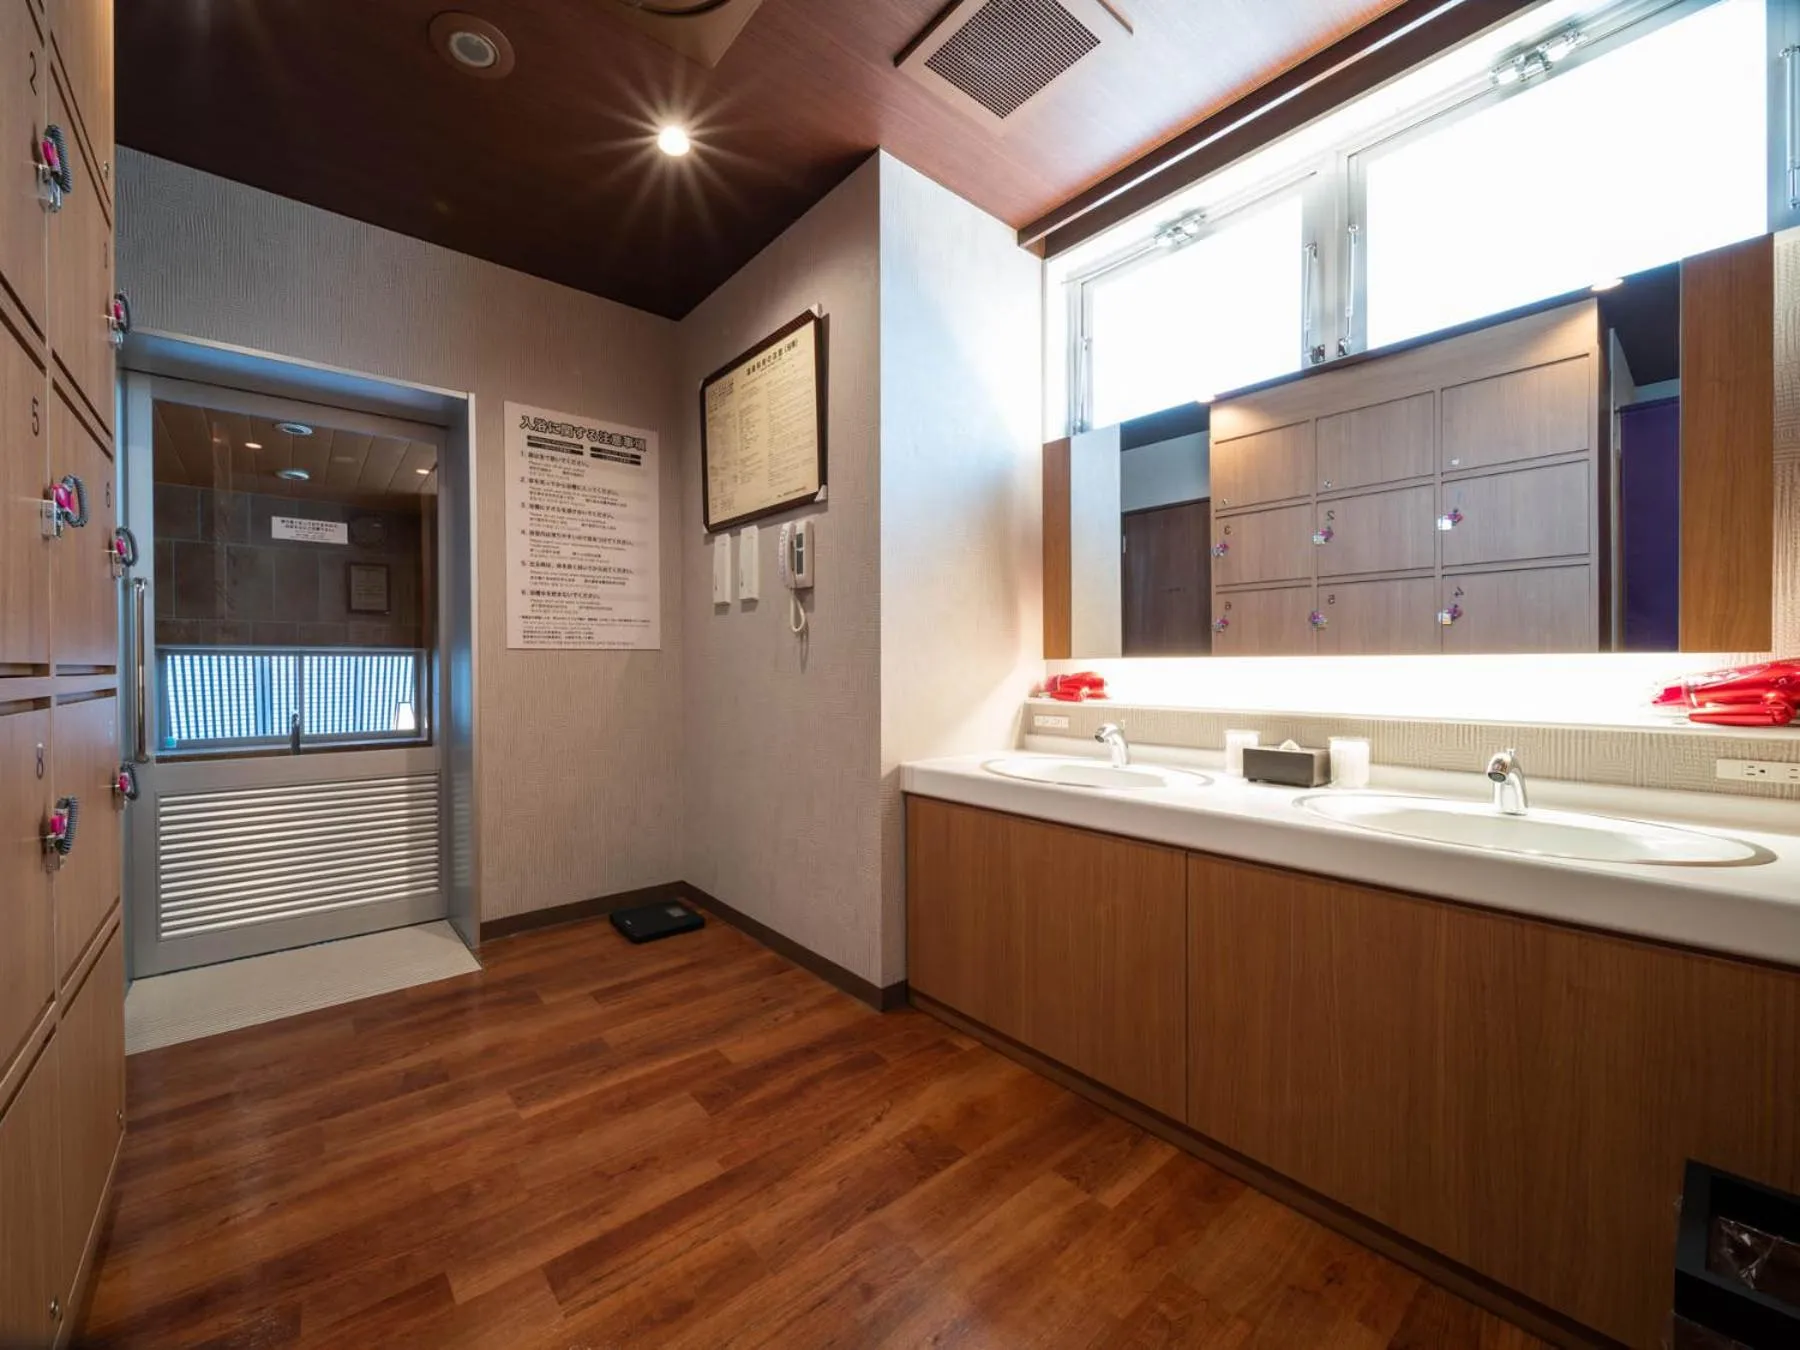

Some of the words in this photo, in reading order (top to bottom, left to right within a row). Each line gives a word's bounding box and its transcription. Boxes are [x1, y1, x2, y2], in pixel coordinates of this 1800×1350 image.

[29, 50, 37, 96] 2
[31, 396, 40, 437] 5
[519, 415, 647, 452] 入浴に関する注意事項
